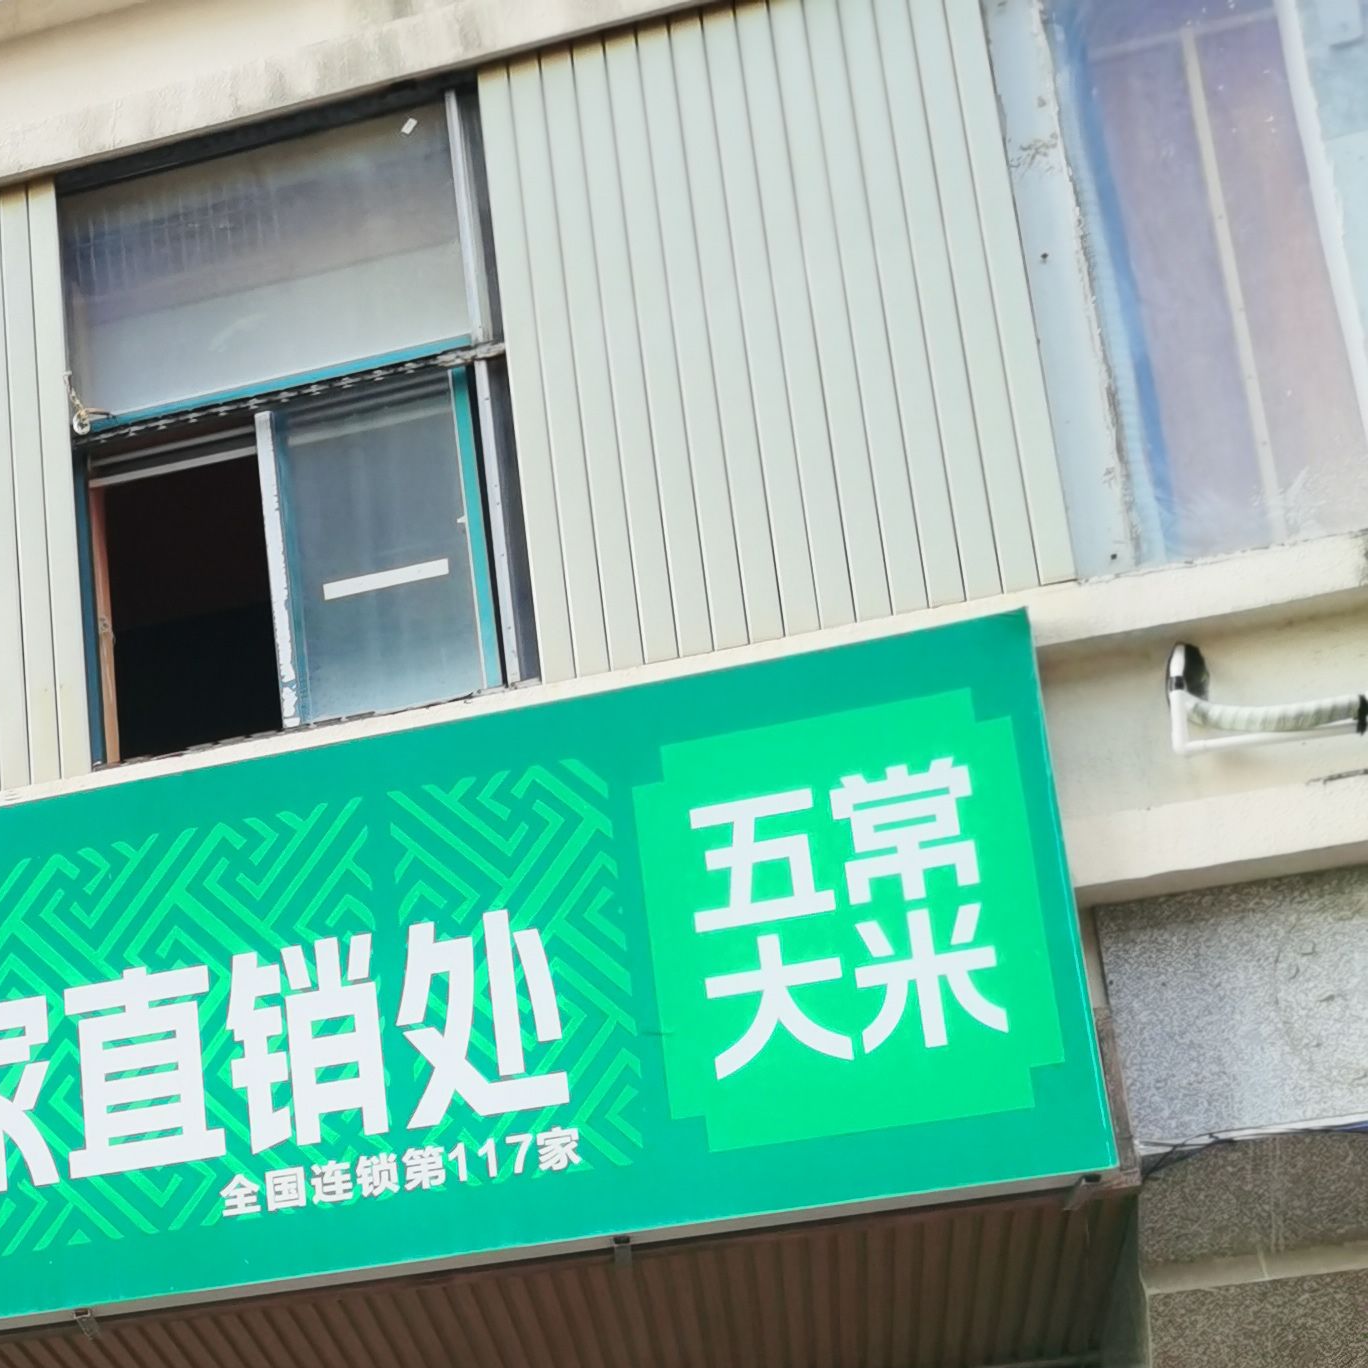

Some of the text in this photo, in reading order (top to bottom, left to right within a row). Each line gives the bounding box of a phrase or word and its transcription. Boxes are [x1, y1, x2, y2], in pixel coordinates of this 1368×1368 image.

[689, 757, 981, 933] 五常
[705, 903, 1009, 1080] 大米
[219, 1126, 582, 1218] 全国连锁第117家
